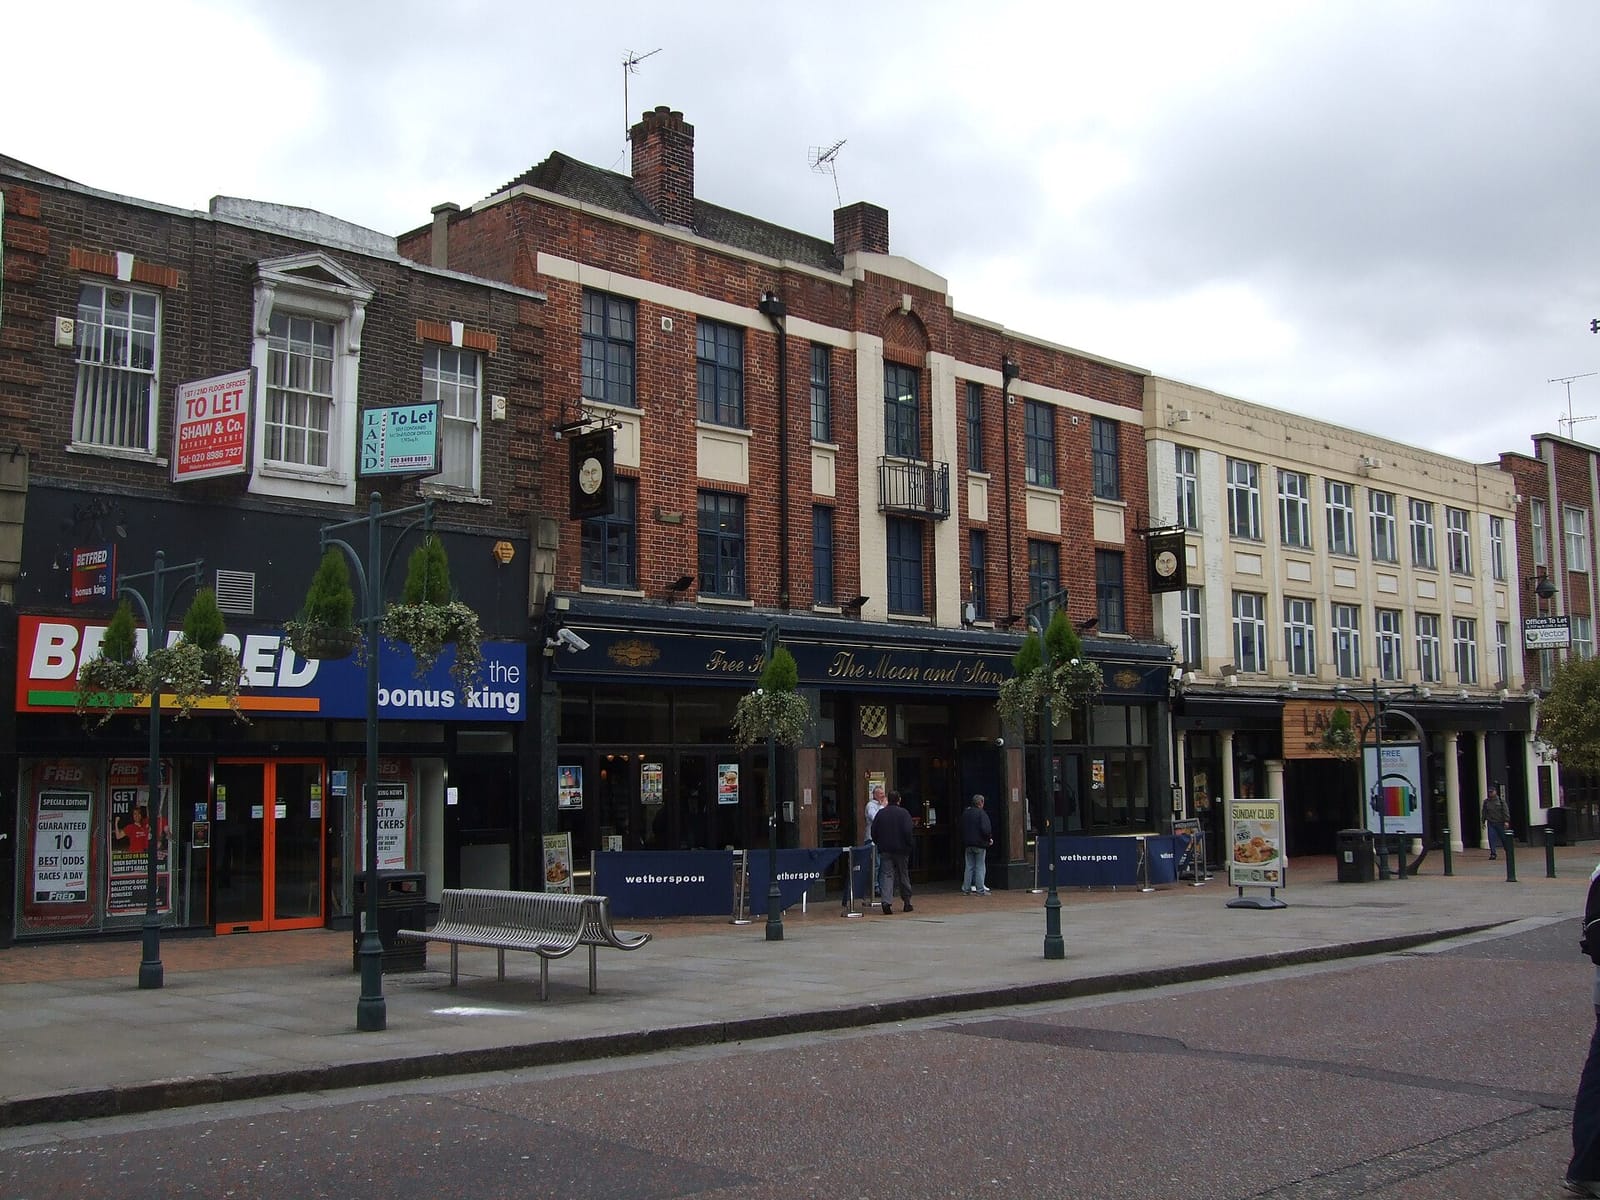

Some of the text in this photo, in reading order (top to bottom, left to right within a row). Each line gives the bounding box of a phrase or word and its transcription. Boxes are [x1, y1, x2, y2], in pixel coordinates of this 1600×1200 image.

[208, 384, 225, 393] FLOOR
[225, 379, 246, 388] OFFICES
[186, 389, 243, 419] TO LET
[390, 410, 433, 425] To Let
[181, 418, 243, 440] SHAW & Co.
[180, 455, 191, 465] Tel:
[191, 453, 205, 462] 020
[76, 550, 108, 567] BETFRED
[75, 584, 106, 597] bonus king
[1539, 630, 1567, 638] Vector
[706, 649, 745, 671] Free
[489, 660, 520, 683] the
[828, 651, 1004, 684] The Moon and Stars
[377, 682, 520, 714] bonus king
[1382, 749, 1401, 757] FREE
[44, 766, 84, 781] FRED
[110, 763, 138, 775] FRED
[43, 797, 87, 806] SPECIAL EDITION
[113, 791, 136, 802] GET
[113, 803, 129, 814] IN!
[1232, 808, 1275, 820] SUNDAY CLUB
[38, 821, 87, 831] GUARANTEED
[55, 834, 73, 850] 10
[38, 856, 85, 866] BEST ODDS
[1060, 854, 1118, 863] wetherspoon
[38, 871, 83, 881] RACES A DAY
[625, 874, 705, 885] wetherspoon
[776, 871, 820, 881] etherspoo
[48, 892, 76, 901] FRED
